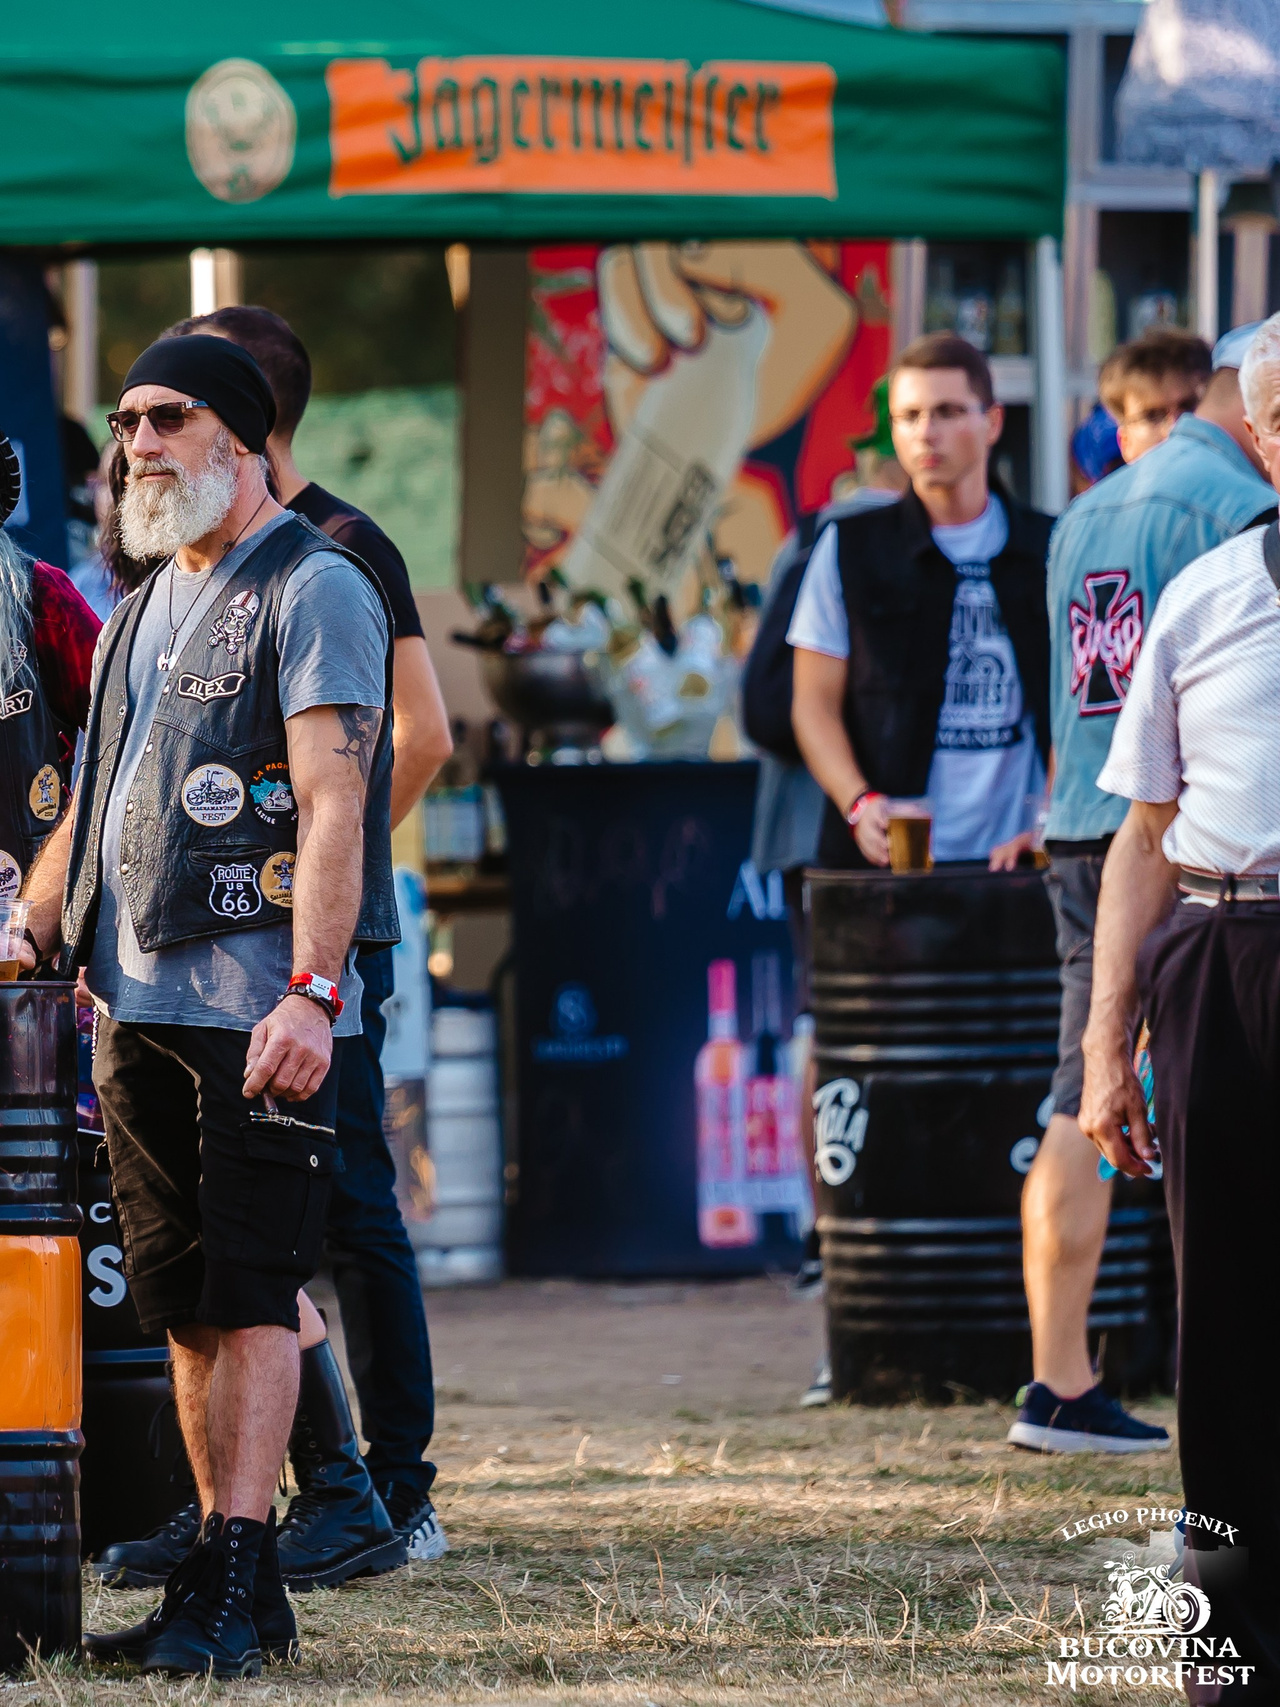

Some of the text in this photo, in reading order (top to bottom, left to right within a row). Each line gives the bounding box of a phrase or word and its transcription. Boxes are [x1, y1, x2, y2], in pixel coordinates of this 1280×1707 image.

[187, 679, 226, 697] ALEX
[253, 762, 289, 781] LA PACH
[201, 812, 226, 821] FEST
[255, 806, 276, 825] LAZISE
[217, 868, 251, 880] ROUTE
[221, 892, 251, 912] 66
